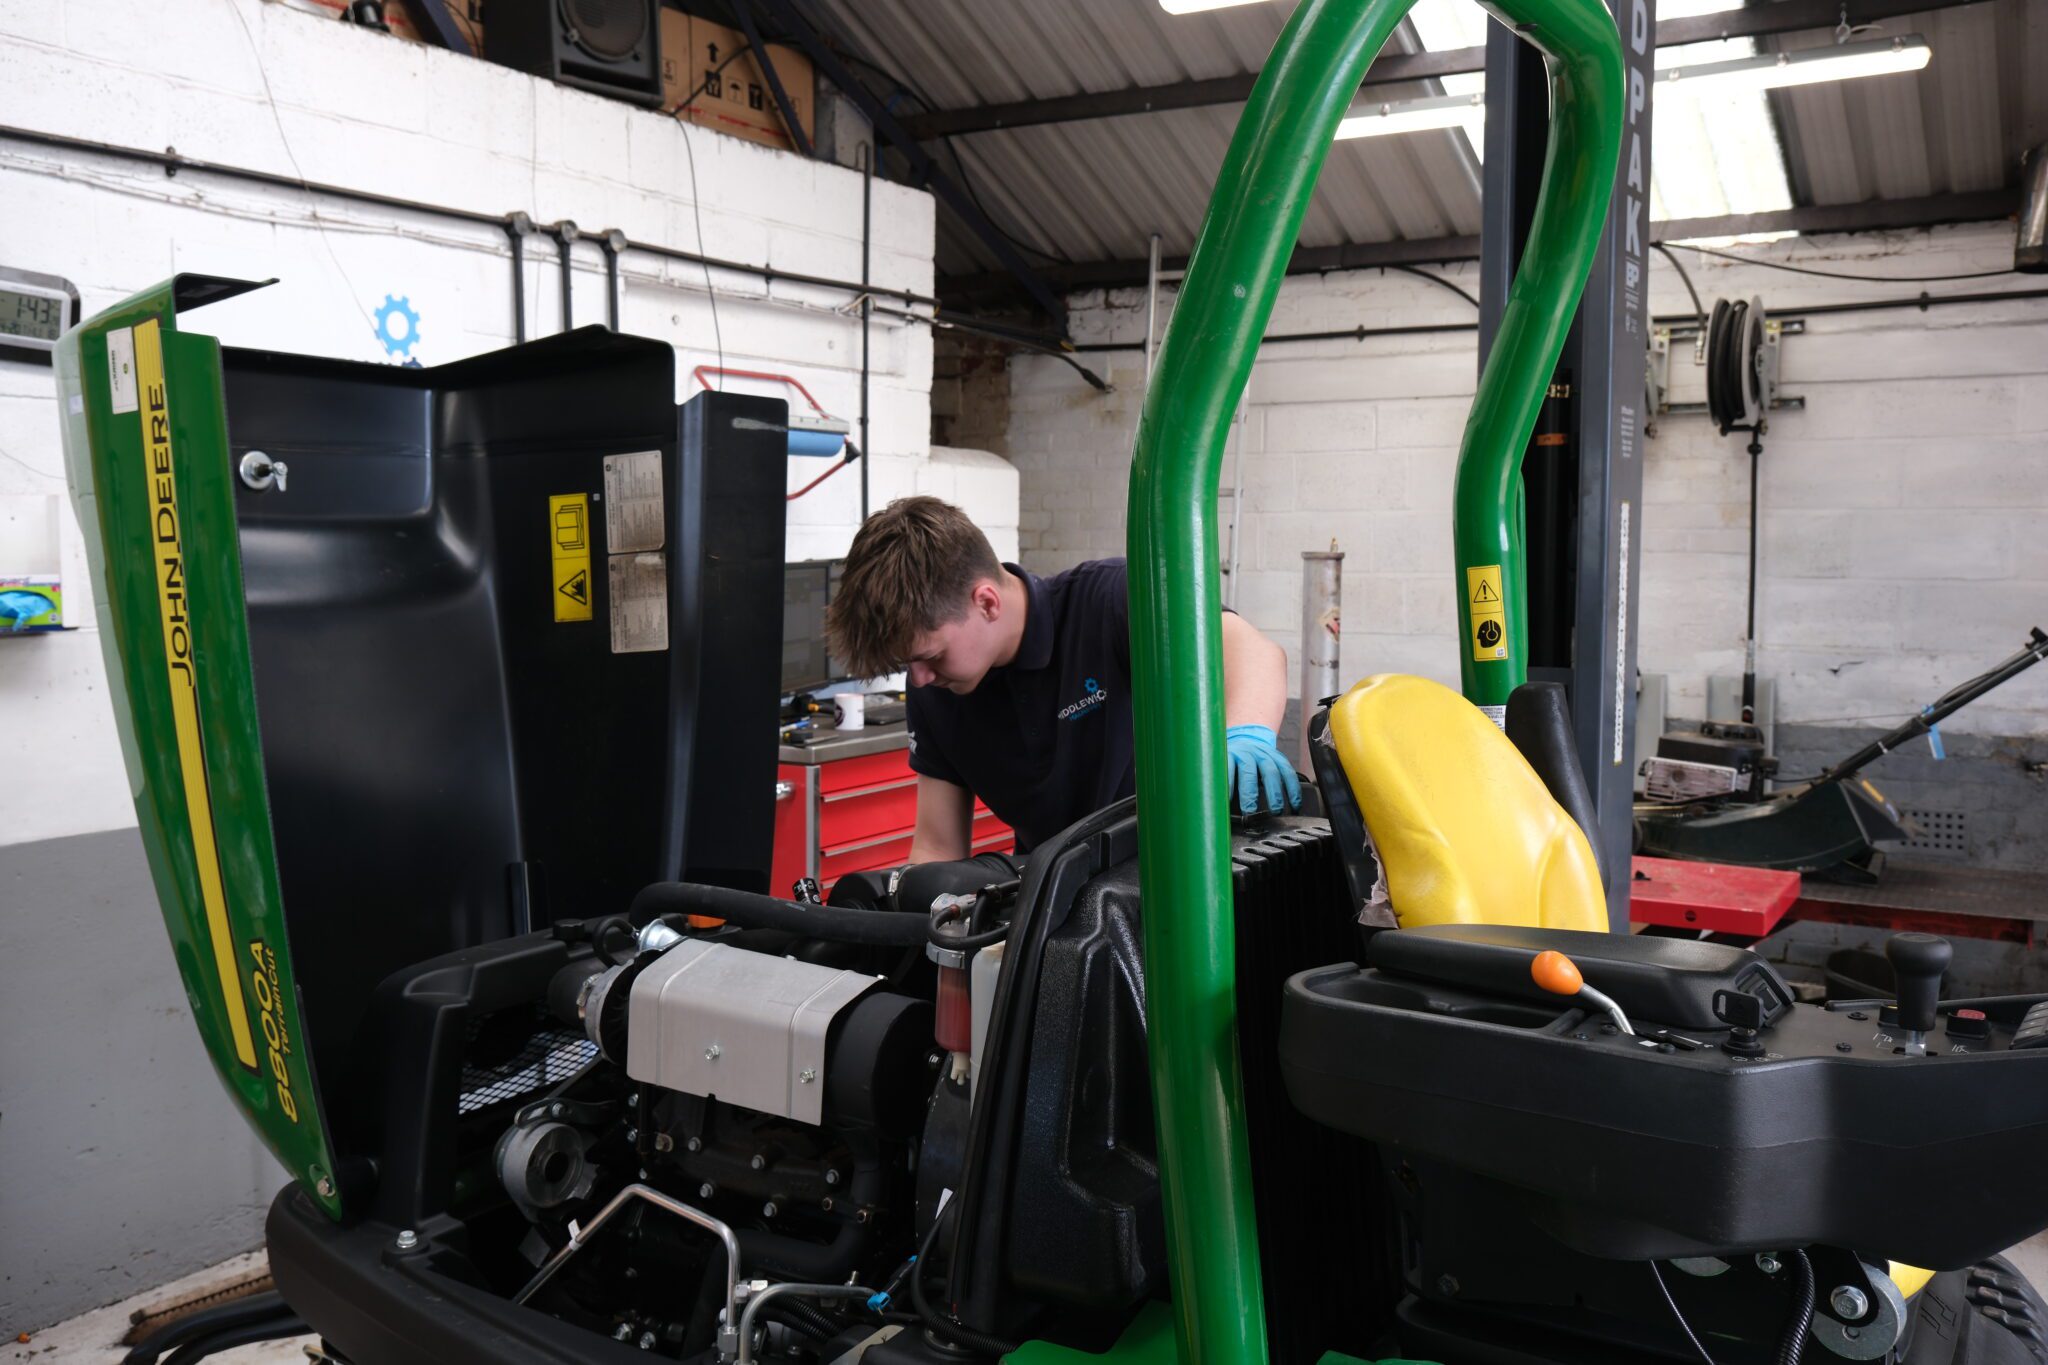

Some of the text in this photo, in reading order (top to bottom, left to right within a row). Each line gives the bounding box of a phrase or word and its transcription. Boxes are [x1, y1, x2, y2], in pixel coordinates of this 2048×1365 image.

[148, 383, 193, 687] JOHN DEERE
[250, 941, 298, 1124] 8800A
[265, 947, 291, 1054] TerrainCut
